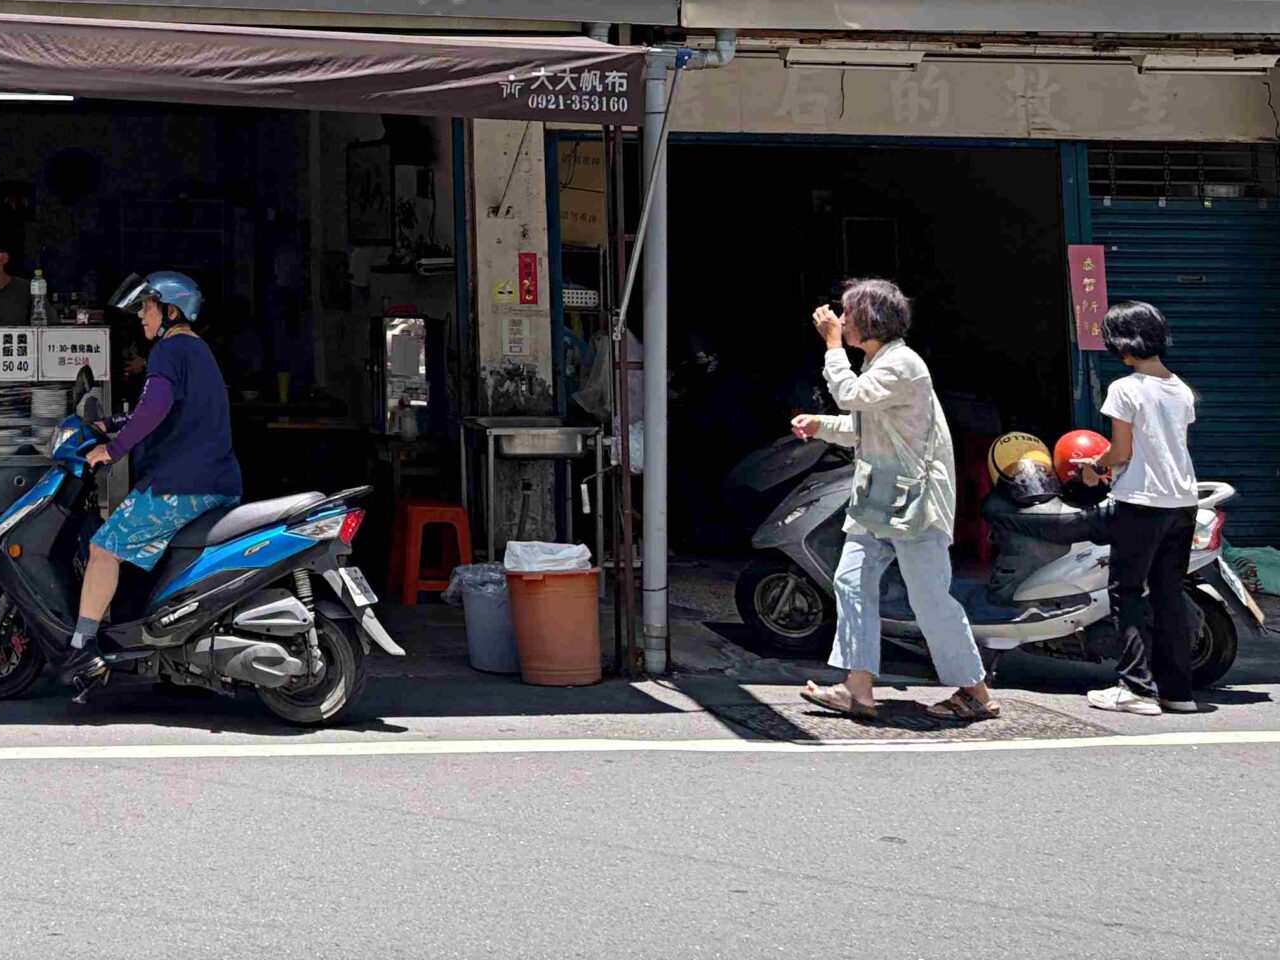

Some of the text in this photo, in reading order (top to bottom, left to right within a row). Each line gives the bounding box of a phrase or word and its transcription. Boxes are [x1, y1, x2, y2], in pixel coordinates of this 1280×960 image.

[529, 66, 629, 93] 大大帆布
[528, 93, 629, 113] 0921-353160
[2, 360, 14, 372] 50
[16, 360, 29, 372] 40
